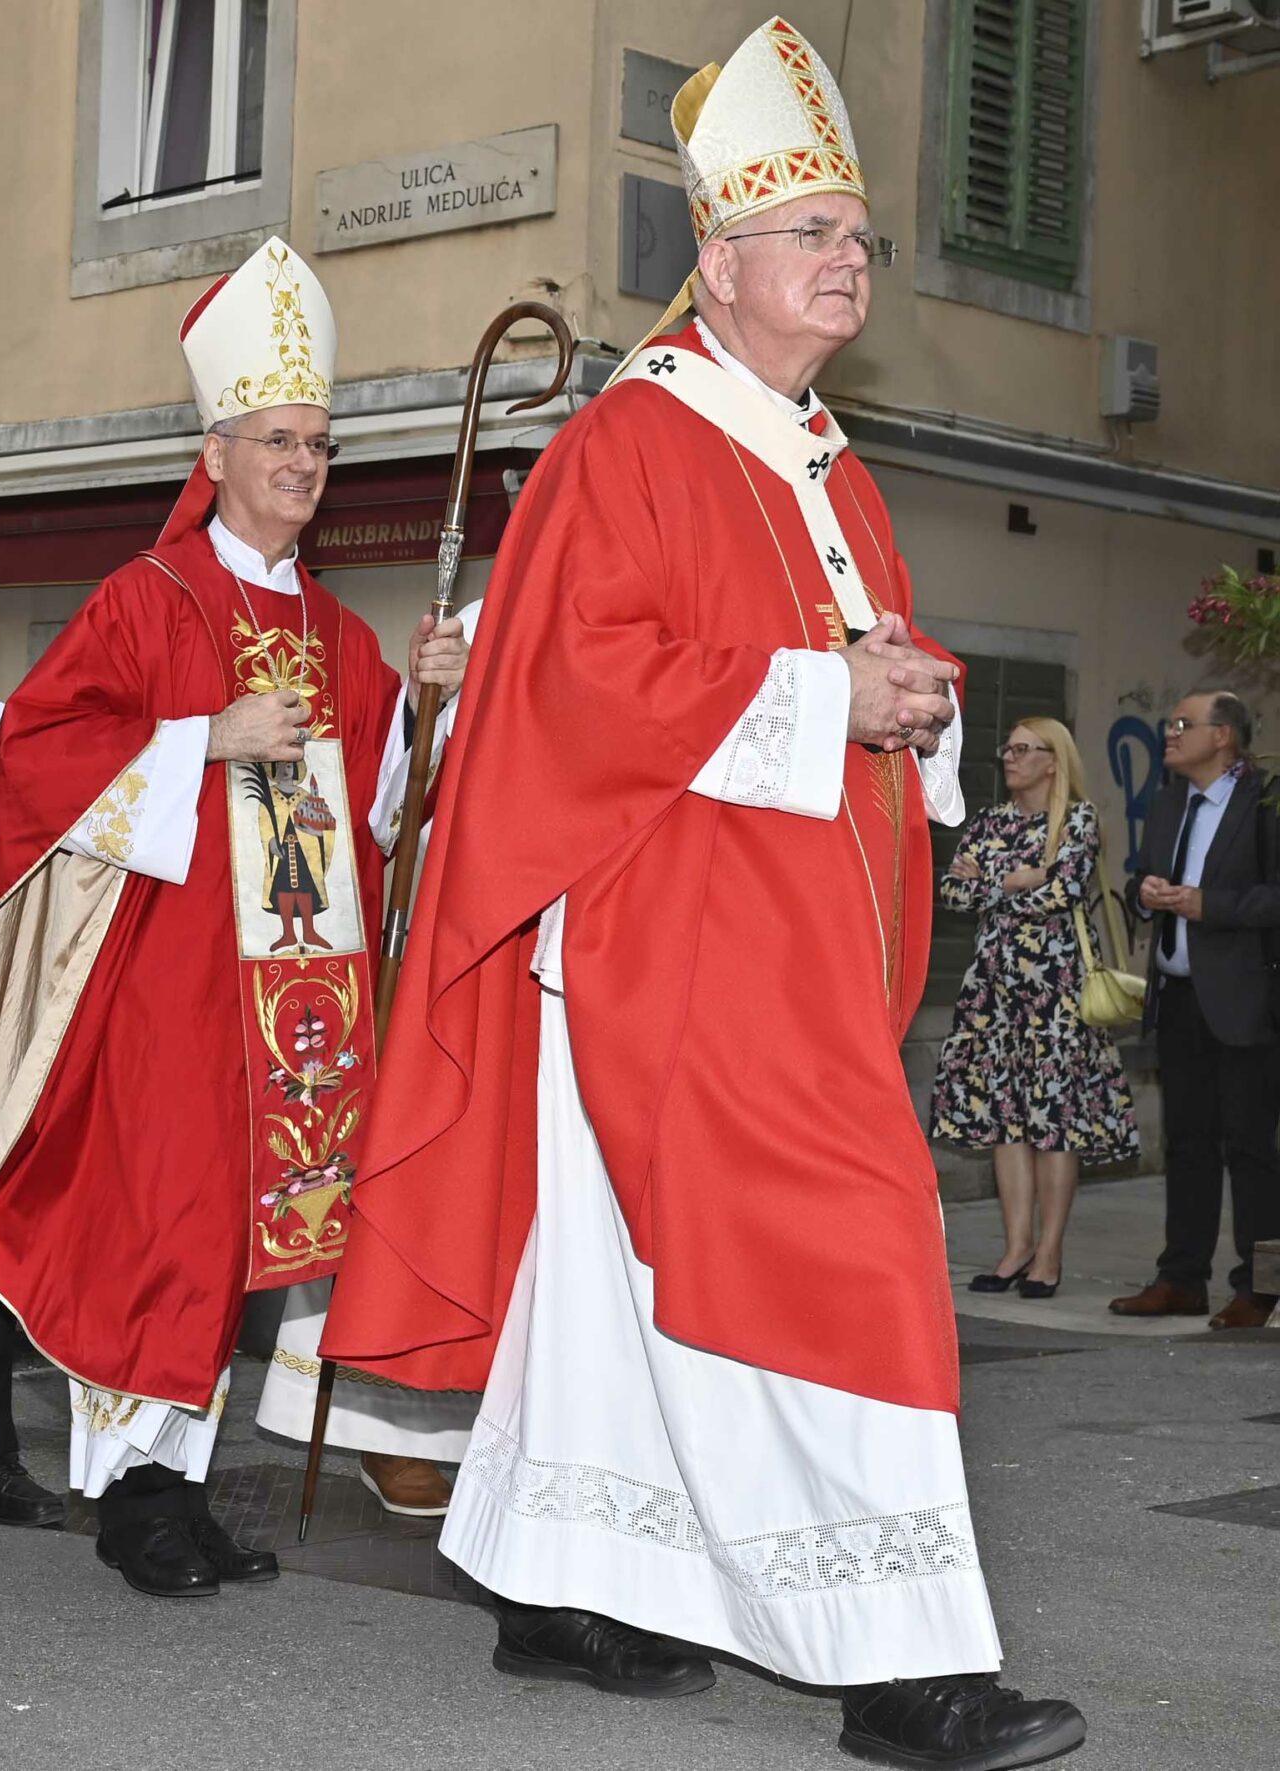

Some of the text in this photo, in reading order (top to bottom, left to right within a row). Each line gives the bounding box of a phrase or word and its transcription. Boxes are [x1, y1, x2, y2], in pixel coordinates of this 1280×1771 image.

[401, 162, 456, 189] ULICA
[336, 176, 524, 231] ANDRIJE MEDULIĆA
[317, 520, 442, 547] HAUSBRANDT
